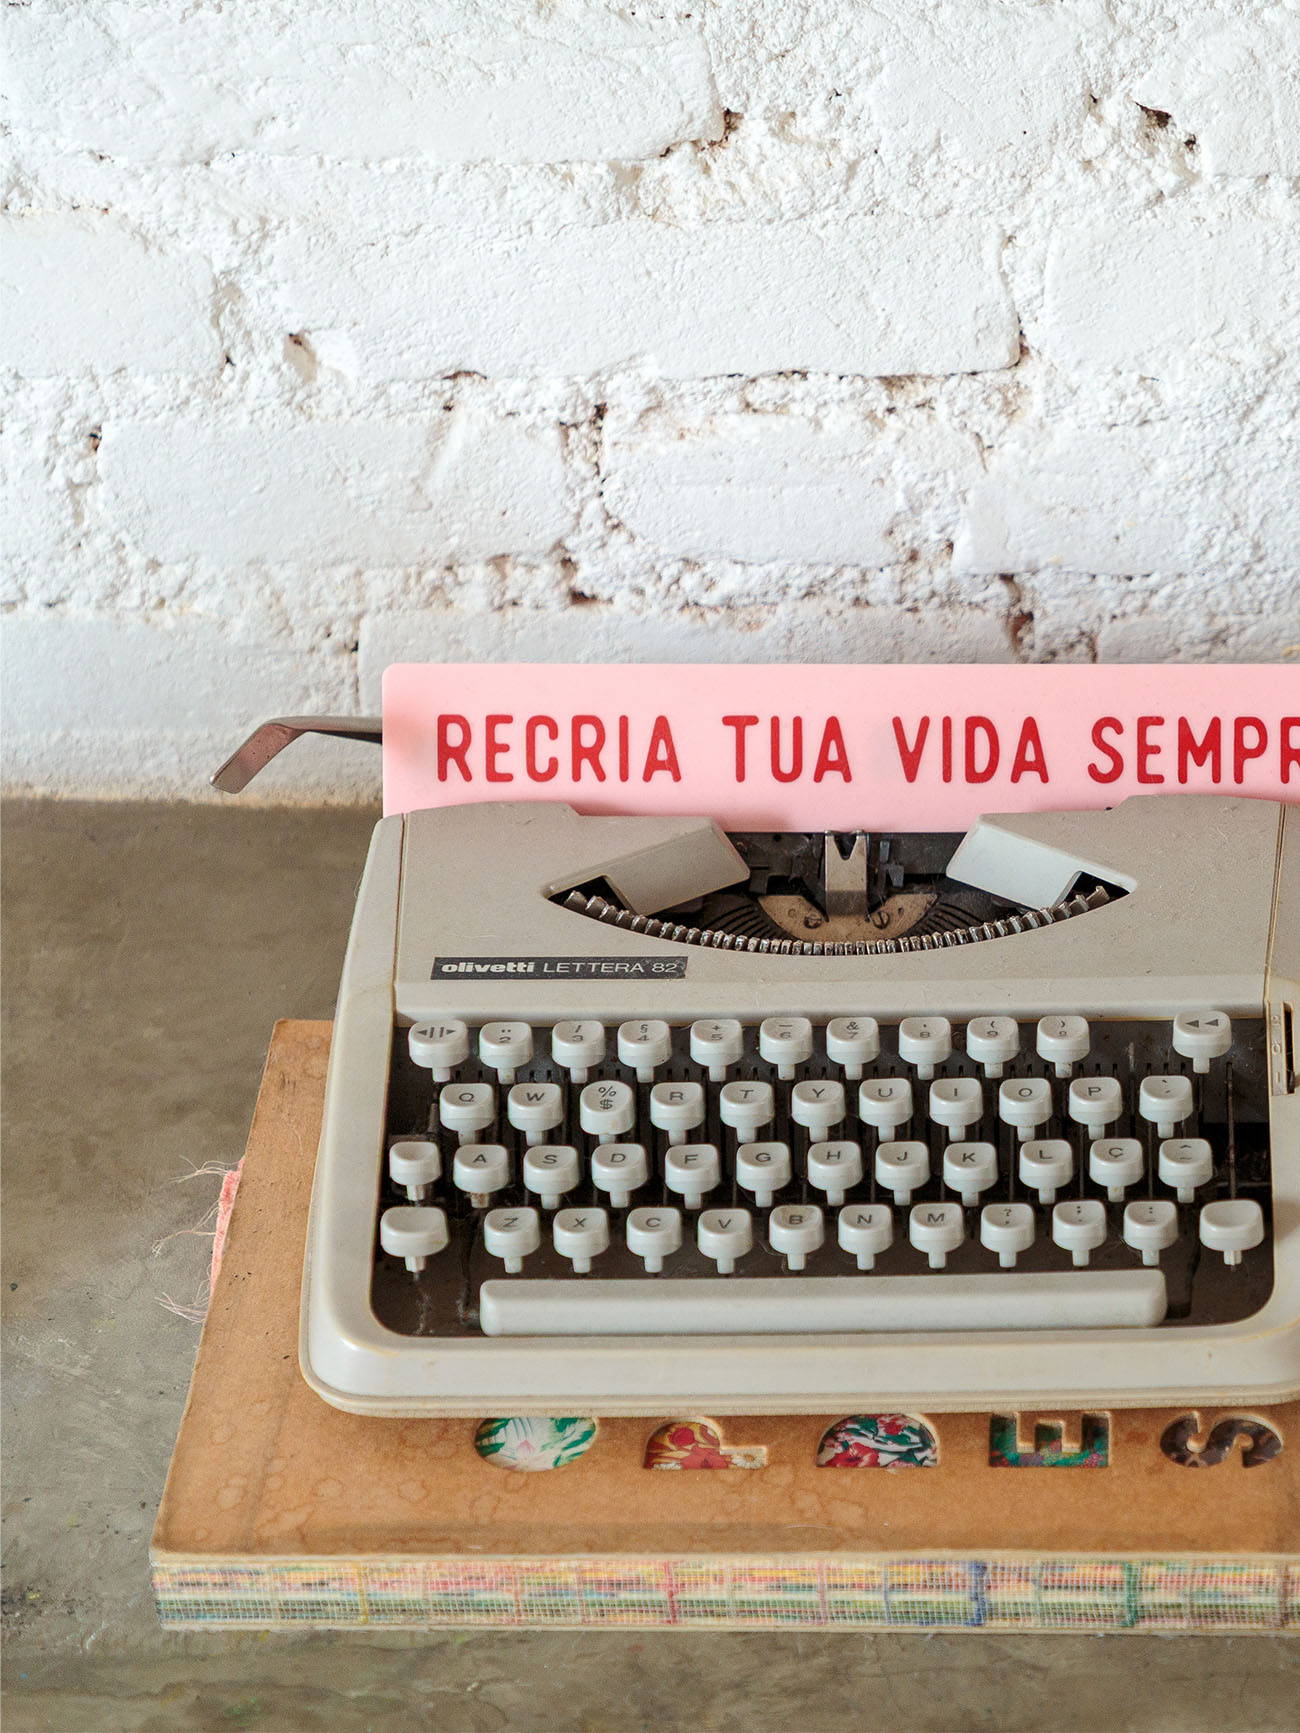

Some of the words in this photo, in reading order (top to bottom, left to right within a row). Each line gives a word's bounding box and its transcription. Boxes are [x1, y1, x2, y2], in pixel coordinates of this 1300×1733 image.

[436, 713, 683, 784] RECRIA
[721, 714, 854, 785] TUA
[891, 715, 1050, 785] VIDA
[440, 960, 536, 975] olivetti
[541, 961, 644, 975] LETTERA
[650, 961, 679, 974] 82
[459, 1092, 475, 1103] Q
[526, 1092, 545, 1102] W
[670, 1091, 684, 1101] R
[740, 1090, 754, 1099] T
[811, 1088, 826, 1098] Y
[878, 1088, 893, 1098] U
[1017, 1088, 1033, 1097] O
[1088, 1086, 1102, 1097] P
[472, 1153, 487, 1164] A
[542, 1154, 557, 1164] S
[610, 1153, 626, 1163] D
[684, 1154, 699, 1164] F
[755, 1152, 772, 1163] G
[826, 1151, 841, 1160] H
[896, 1151, 909, 1161] J
[962, 1153, 976, 1163] K
[1038, 1150, 1053, 1160] L
[503, 1217, 520, 1228] Z
[573, 1218, 587, 1228] X
[645, 1217, 662, 1228] C
[717, 1218, 732, 1229] V
[789, 1215, 804, 1225] B
[857, 1214, 873, 1225] N
[927, 1212, 945, 1223] M
